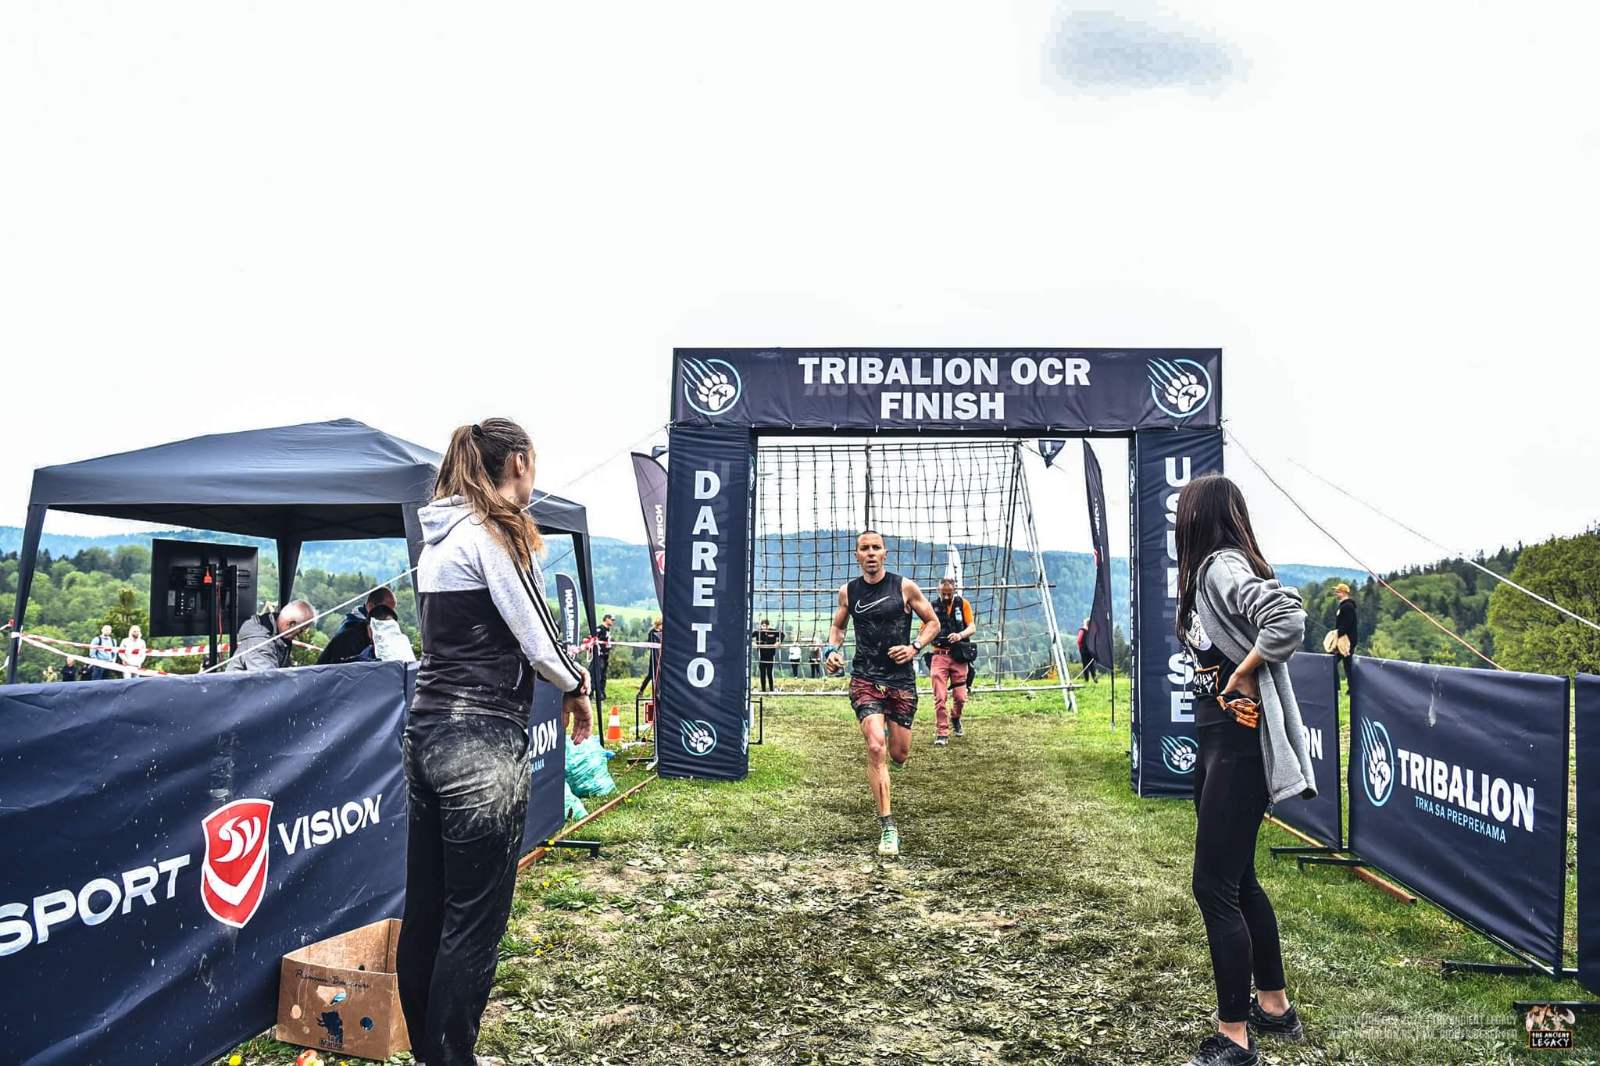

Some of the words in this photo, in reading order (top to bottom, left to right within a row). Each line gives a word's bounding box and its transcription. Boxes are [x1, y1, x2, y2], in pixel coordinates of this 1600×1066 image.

[798, 356, 999, 386] TRIBALION
[1010, 357, 1092, 386] OCR
[880, 391, 1005, 421] FINISH
[691, 470, 721, 607] DARE
[686, 622, 715, 688] TO
[1397, 748, 1535, 833] TRIBALION
[1414, 795, 1434, 815] TRKA
[1434, 804, 1446, 819] SA
[1446, 808, 1507, 844] PREPREKAMA
[0, 853, 191, 957] SPORT
[277, 793, 383, 856] VISION
